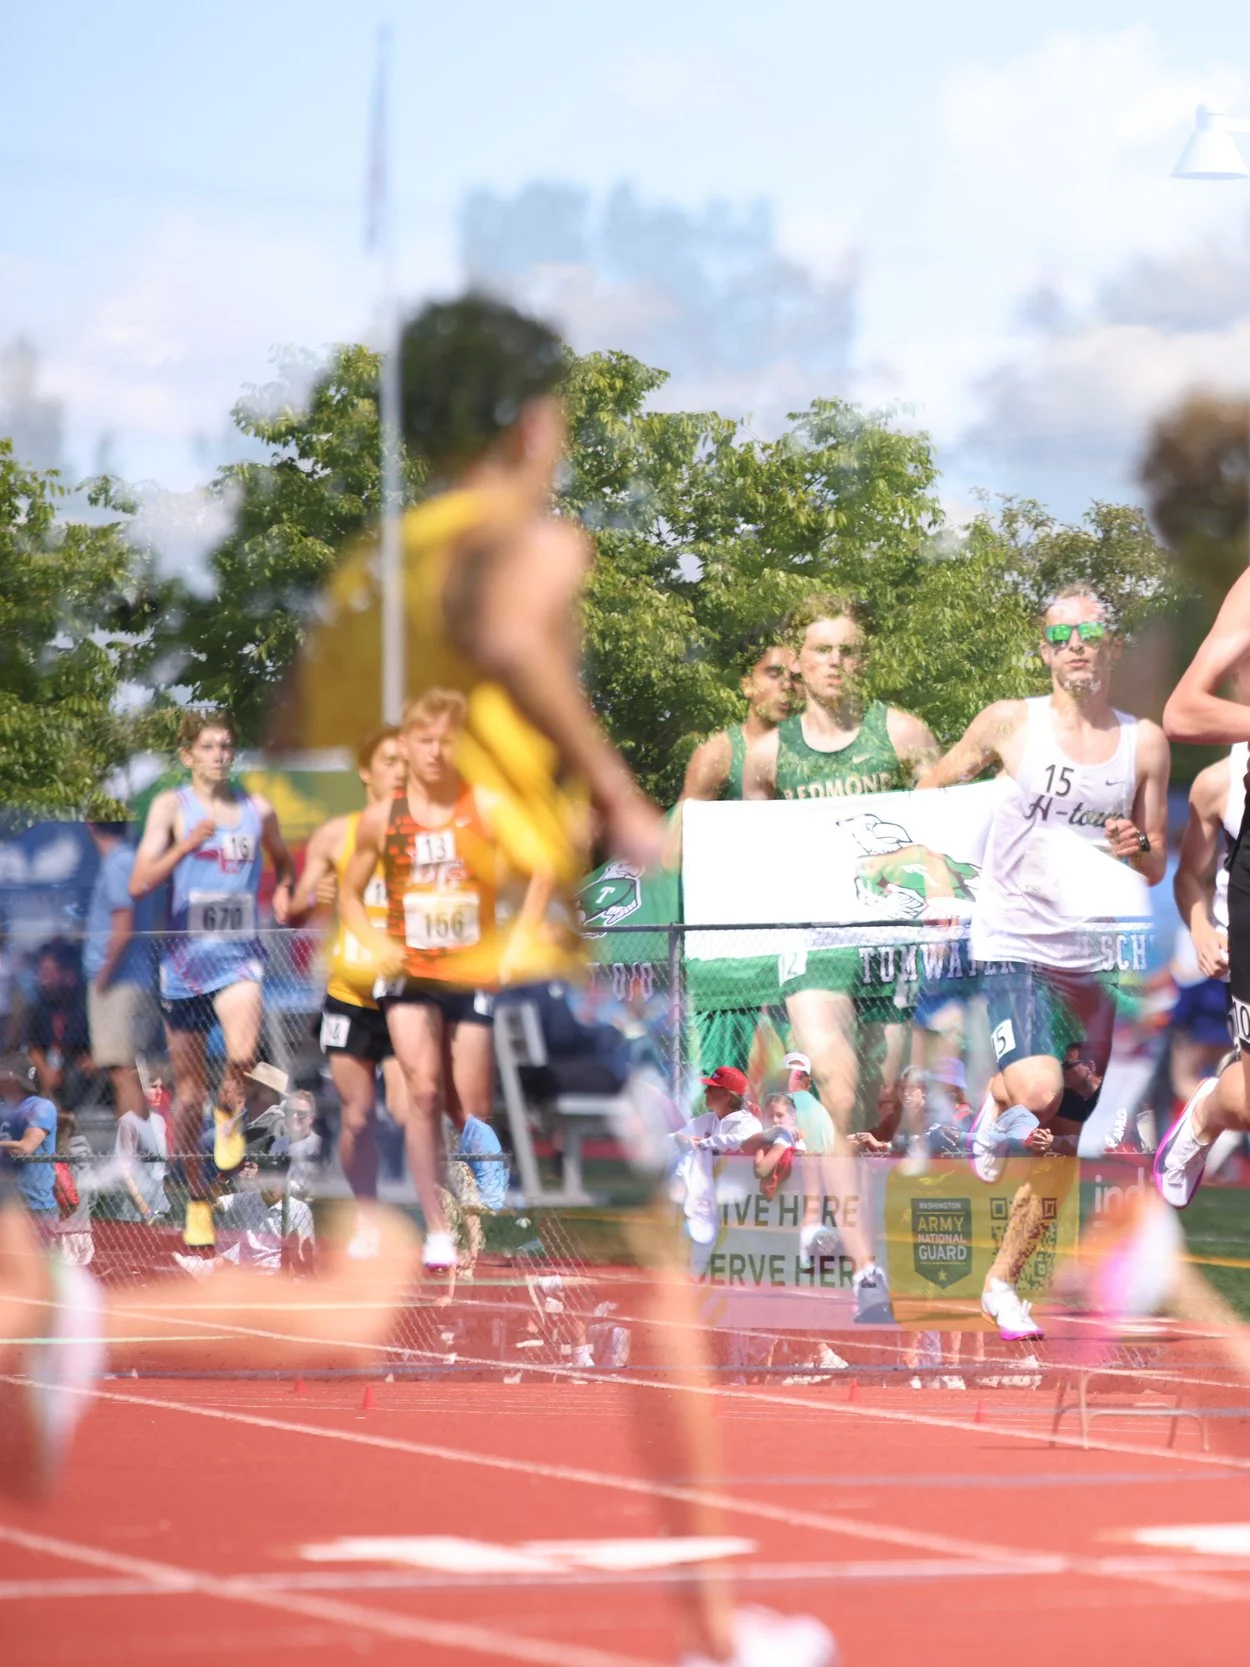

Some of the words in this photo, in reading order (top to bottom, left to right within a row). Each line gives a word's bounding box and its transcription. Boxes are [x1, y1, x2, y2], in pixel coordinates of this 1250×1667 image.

[1046, 764, 1075, 797] 15
[425, 837, 446, 860] 13
[721, 1194, 769, 1227] IVE
[779, 1194, 860, 1227] HERE
[918, 1216, 964, 1232] ARMY
[918, 1234, 966, 1243] NATIONAL
[918, 1245, 967, 1260] GUARD
[699, 1253, 786, 1287] ERVE
[795, 1254, 876, 1288] HER
